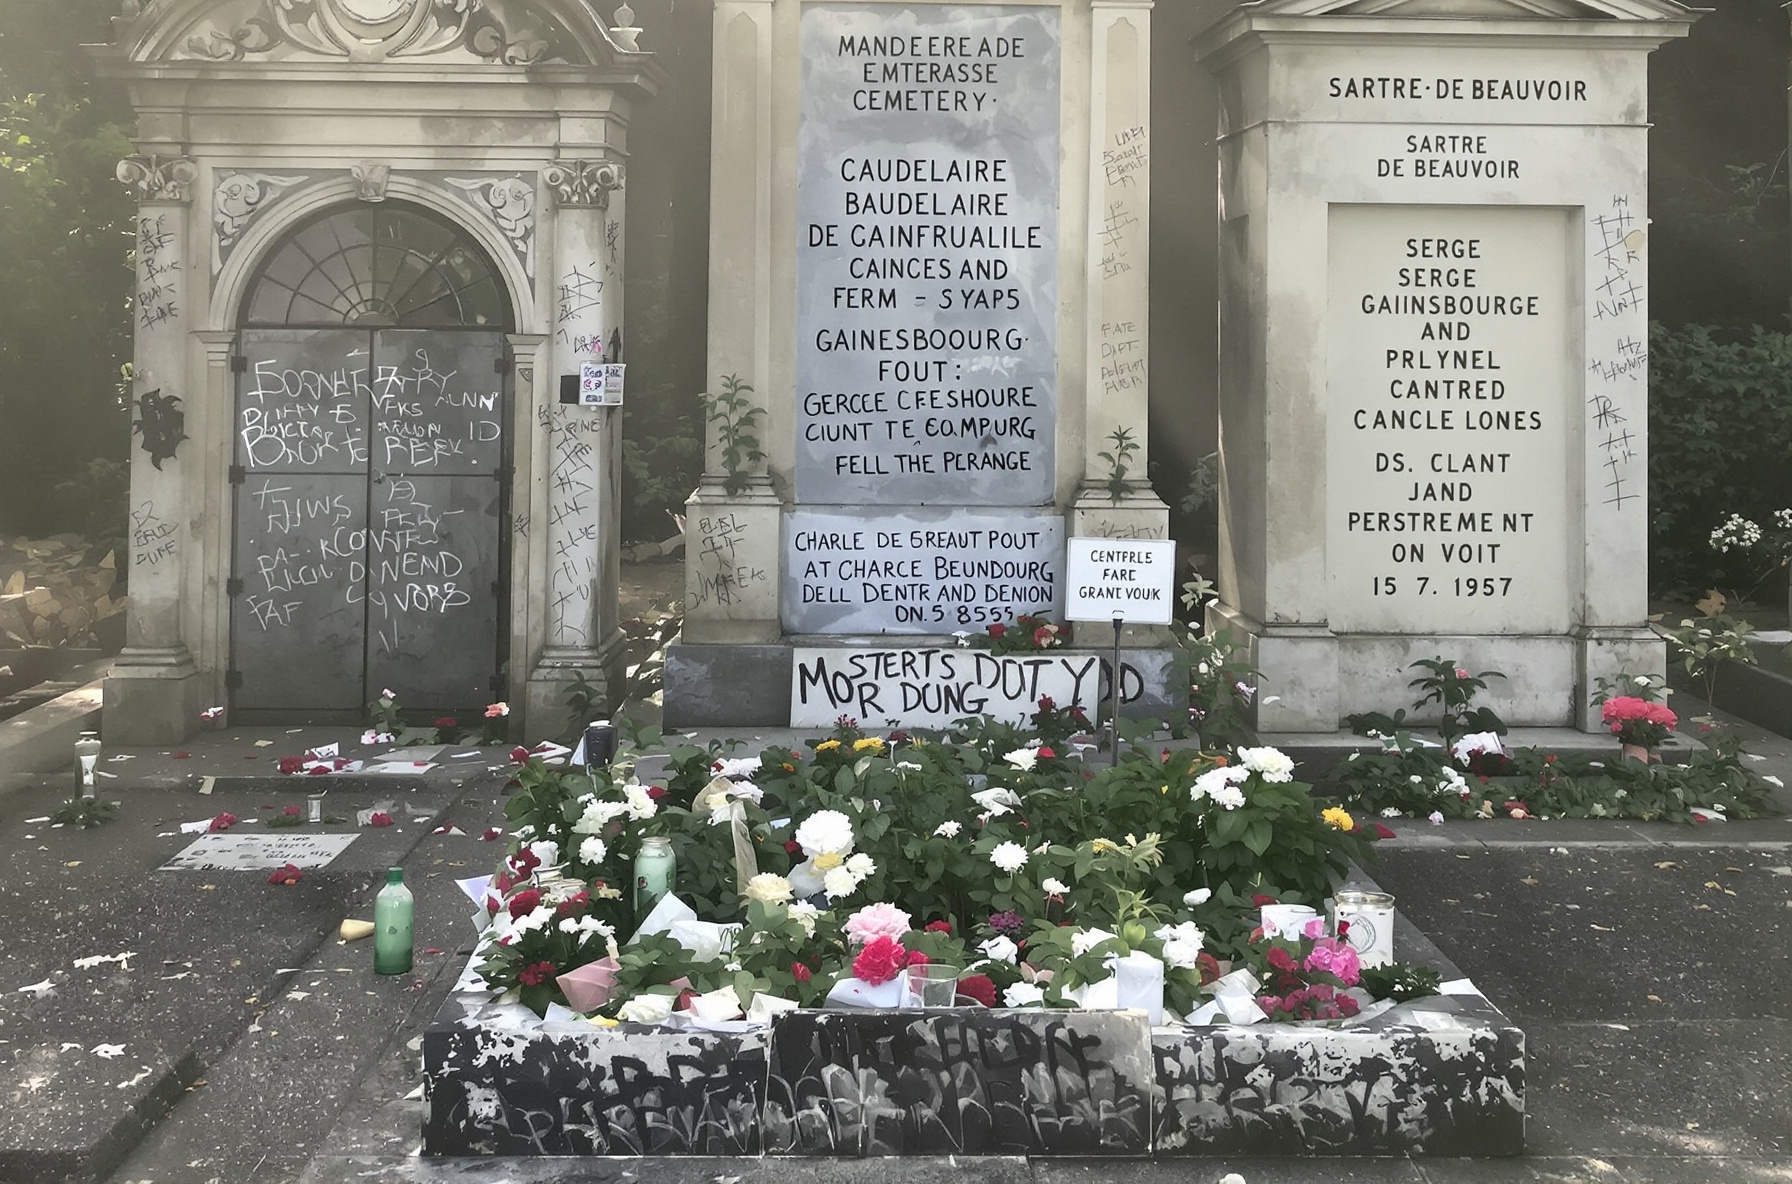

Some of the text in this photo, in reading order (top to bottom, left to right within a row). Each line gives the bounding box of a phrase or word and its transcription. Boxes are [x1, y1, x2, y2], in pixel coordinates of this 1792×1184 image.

[863, 62, 998, 84] EMTERASSE
[1472, 79, 1587, 101] BEAUVOIR
[1406, 135, 1488, 155] SARTRE
[840, 157, 1007, 184] CAUDELAIRE
[1377, 158, 1520, 179] DE BEAUVOIR
[844, 192, 1009, 217] BAUDELAIRE
[808, 224, 839, 248] DE
[1405, 238, 1481, 259] SERGE
[849, 257, 1008, 281] CAINCES AND
[1398, 268, 1477, 288] SERGE
[833, 287, 897, 310] FERM
[1420, 321, 1471, 341] AND
[1386, 349, 1502, 370] PRLYNEL
[1390, 379, 1506, 400] CANTRED
[1353, 409, 1543, 431] CANCLE LONES
[835, 454, 890, 476] FELL
[893, 453, 936, 474] THE
[1430, 453, 1512, 474] CLANT
[1408, 482, 1473, 502] JAND
[794, 530, 866, 552] CHARLE
[876, 531, 904, 550] DE
[988, 531, 1041, 551] POUT
[1391, 543, 1502, 564] ON VOIT
[804, 556, 1054, 584] AT CHARCE BEUNDOURG
[802, 583, 852, 604] DELL
[936, 583, 977, 603] AND
[1373, 576, 1398, 596] 15
[1453, 576, 1514, 597] 1957
[900, 680, 989, 715] DUNG
